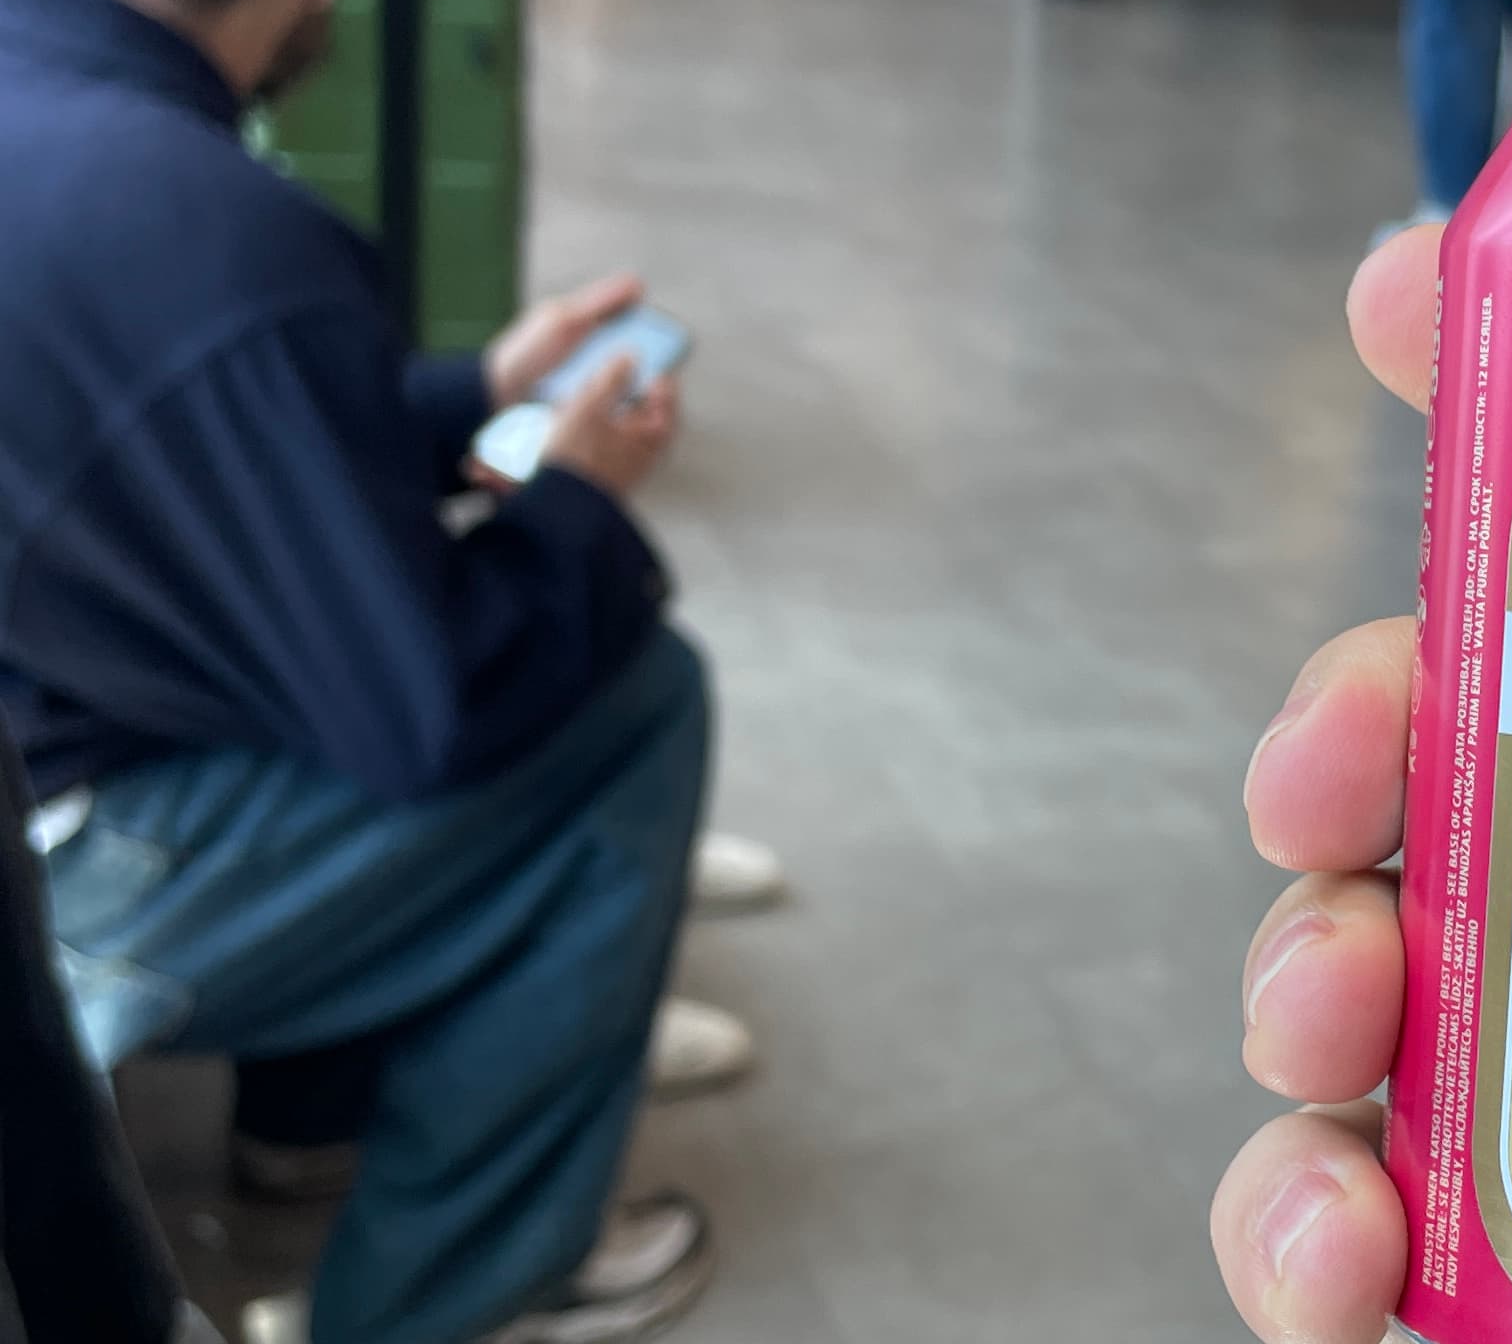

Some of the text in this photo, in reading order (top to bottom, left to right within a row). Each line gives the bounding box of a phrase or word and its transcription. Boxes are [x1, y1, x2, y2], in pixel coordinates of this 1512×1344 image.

[1478, 371, 1488, 388] 12
[1477, 554, 1489, 598] PURGI
[1474, 601, 1486, 649] VAATA
[1471, 652, 1483, 695] ENNE:
[1468, 698, 1480, 746] PARIM
[1461, 762, 1476, 827] APAKŠAS
[1451, 812, 1461, 829] OF
[1449, 833, 1460, 868] BASE
[1457, 829, 1472, 897] BUNDŽAS
[1446, 872, 1457, 896] SEE
[1456, 901, 1467, 919] UZ
[1442, 908, 1455, 962] BEFORE
[1440, 966, 1451, 999] BEST
[1437, 1013, 1448, 1058] POHJA
[1432, 1062, 1445, 1111] TÖLKIN
[1430, 1114, 1441, 1159] KATSO
[1426, 1170, 1438, 1220] ENNEN
[1439, 1192, 1449, 1207] SE
[1422, 1223, 1435, 1285] PARASTA
[1446, 1254, 1458, 1297] ENJOY
